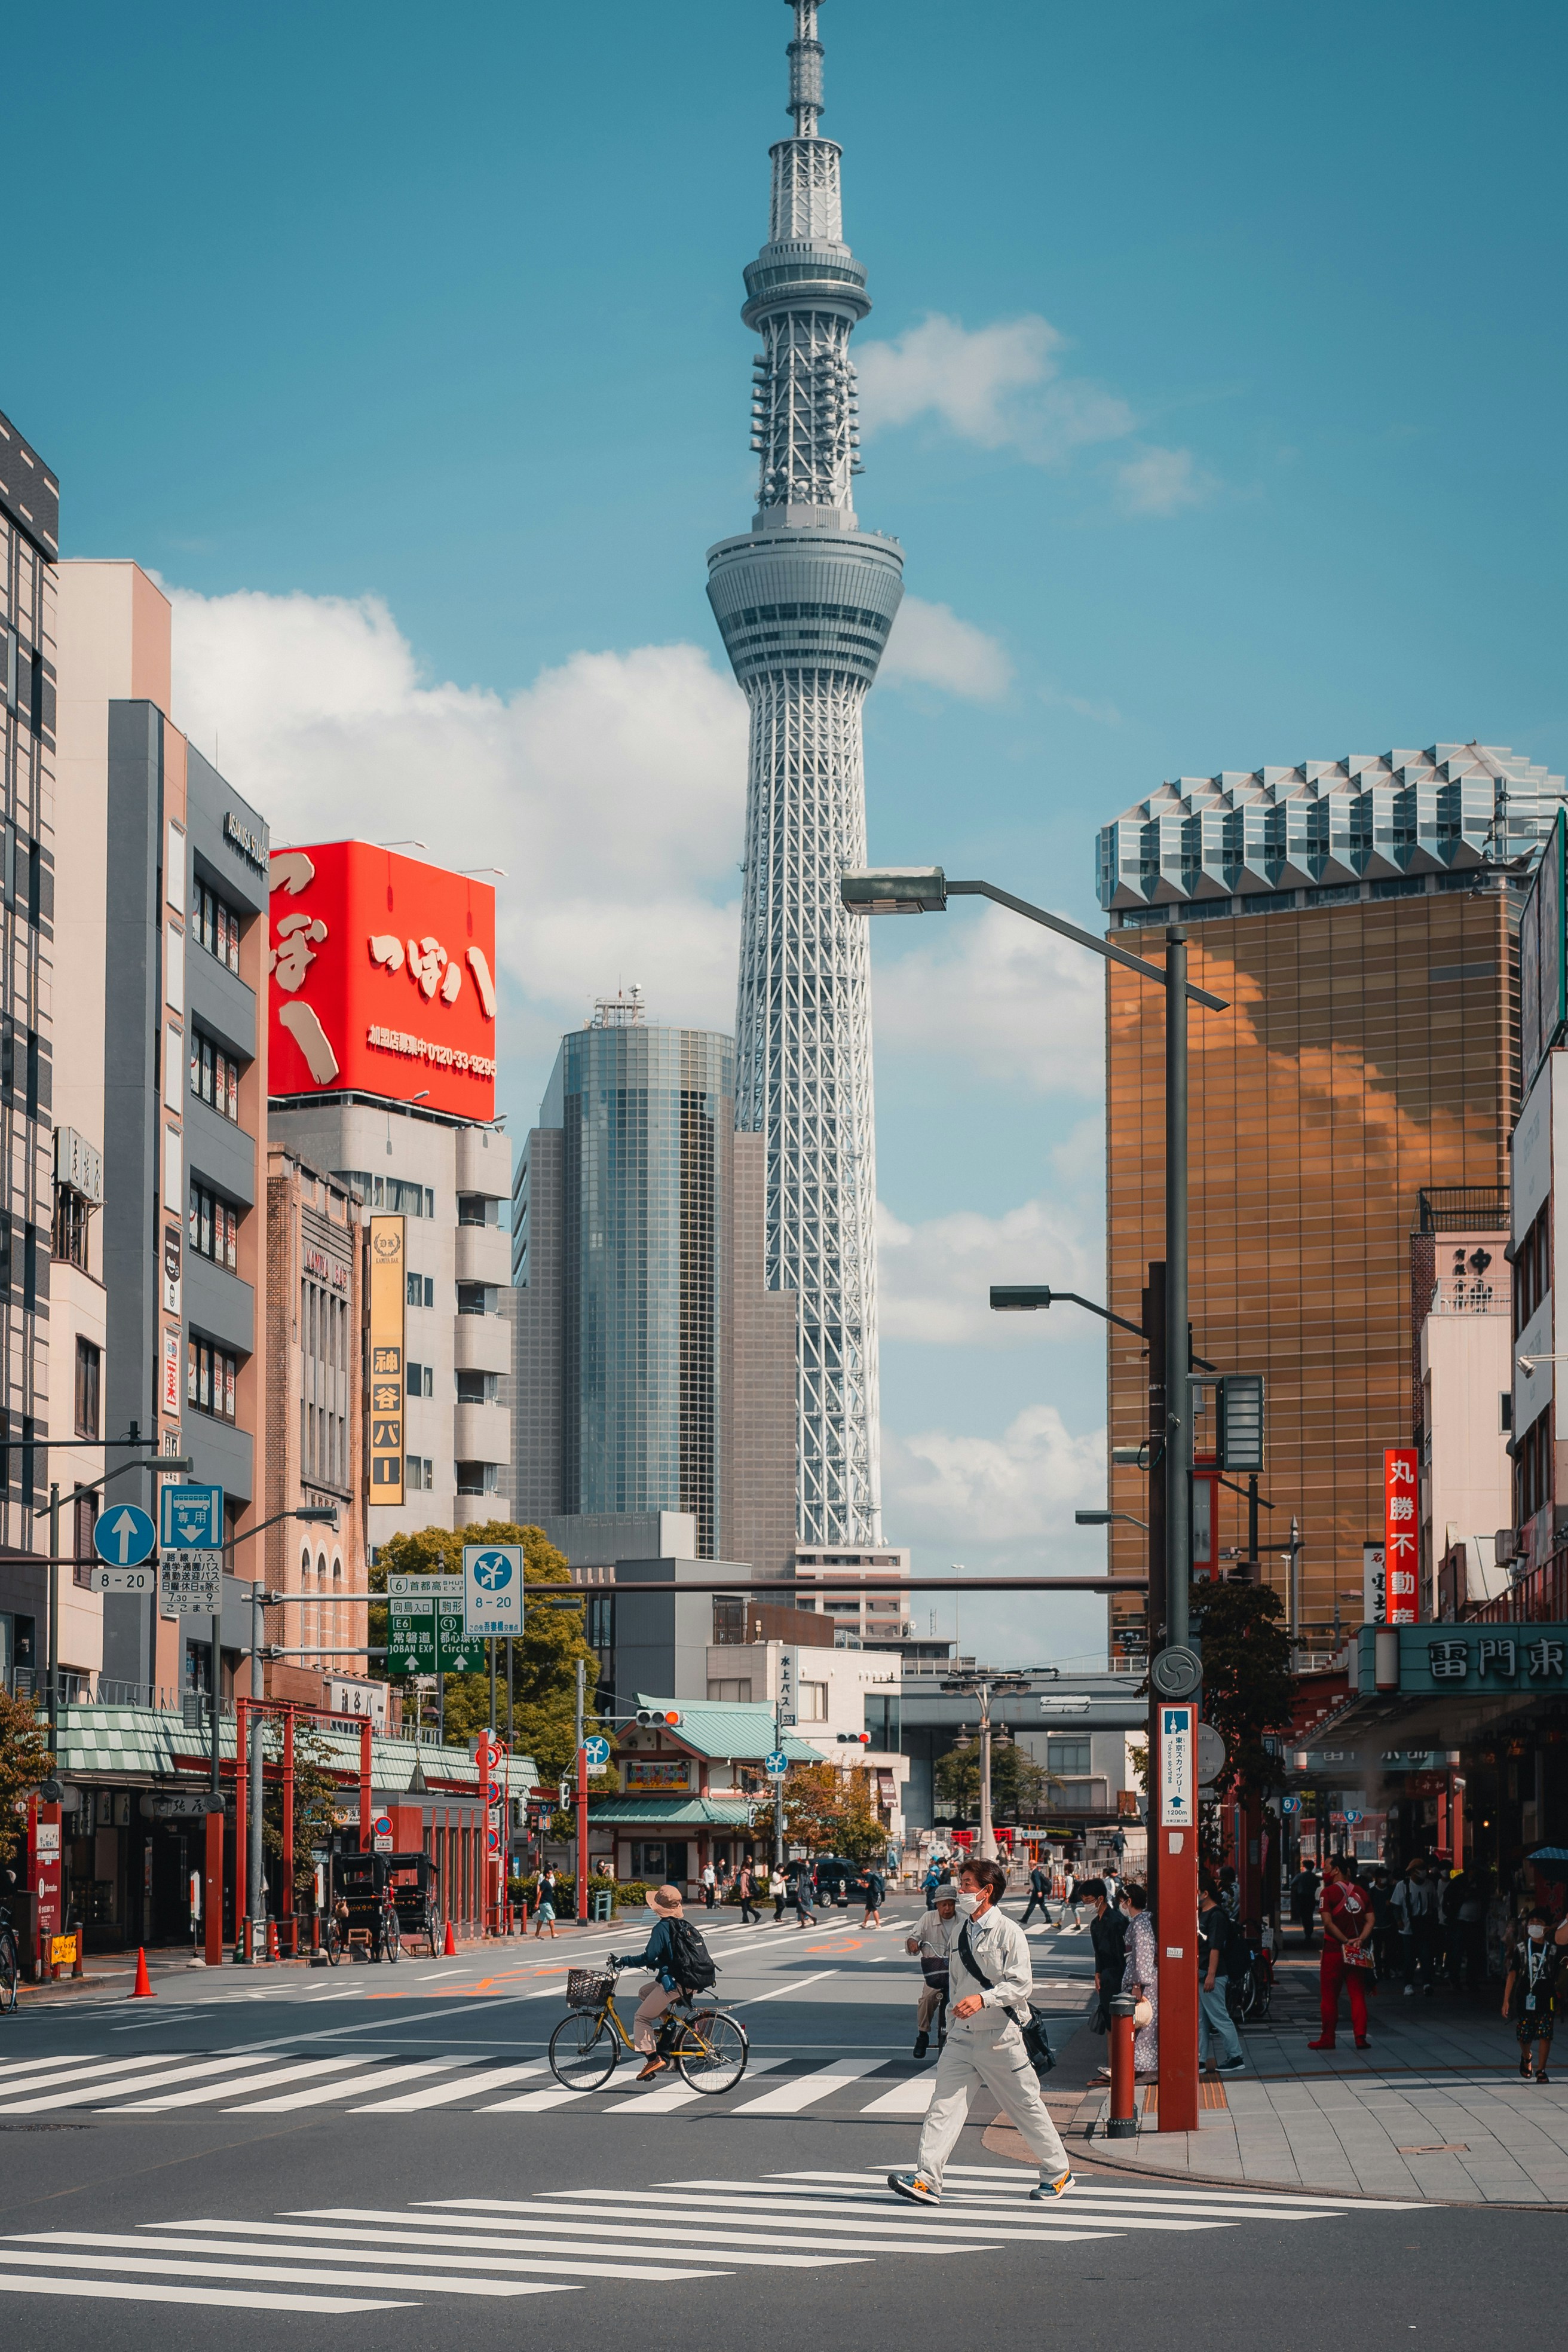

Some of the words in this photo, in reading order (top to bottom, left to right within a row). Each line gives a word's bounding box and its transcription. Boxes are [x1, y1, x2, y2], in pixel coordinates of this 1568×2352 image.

[368, 935, 497, 1018] つぼ八
[427, 1043, 497, 1077] 0120-33-9295
[307, 1247, 329, 1278] KAMIYA
[335, 1264, 347, 1290] BAR
[167, 1363, 176, 1399] 薬
[374, 1350, 399, 1482] 神谷バー
[177, 1511, 206, 1523] 専用
[167, 1553, 215, 1562] 路線バス
[162, 1572, 220, 1581] 通勤送迎バス
[396, 1580, 402, 1591] 6
[410, 1581, 442, 1591] 首都高
[394, 1601, 430, 1613] 向島入口
[442, 1601, 462, 1612] 駒形
[396, 1619, 409, 1628] E6
[443, 1619, 453, 1628] C1
[393, 1632, 431, 1643] 常磐道
[390, 1644, 416, 1654] JOBAN
[419, 1644, 434, 1653] EXP
[442, 1644, 470, 1653] Circle
[1430, 1638, 1563, 1677] 雷門東
[780, 1656, 791, 1706] 水上バス
[1284, 1799, 1291, 1809] 6
